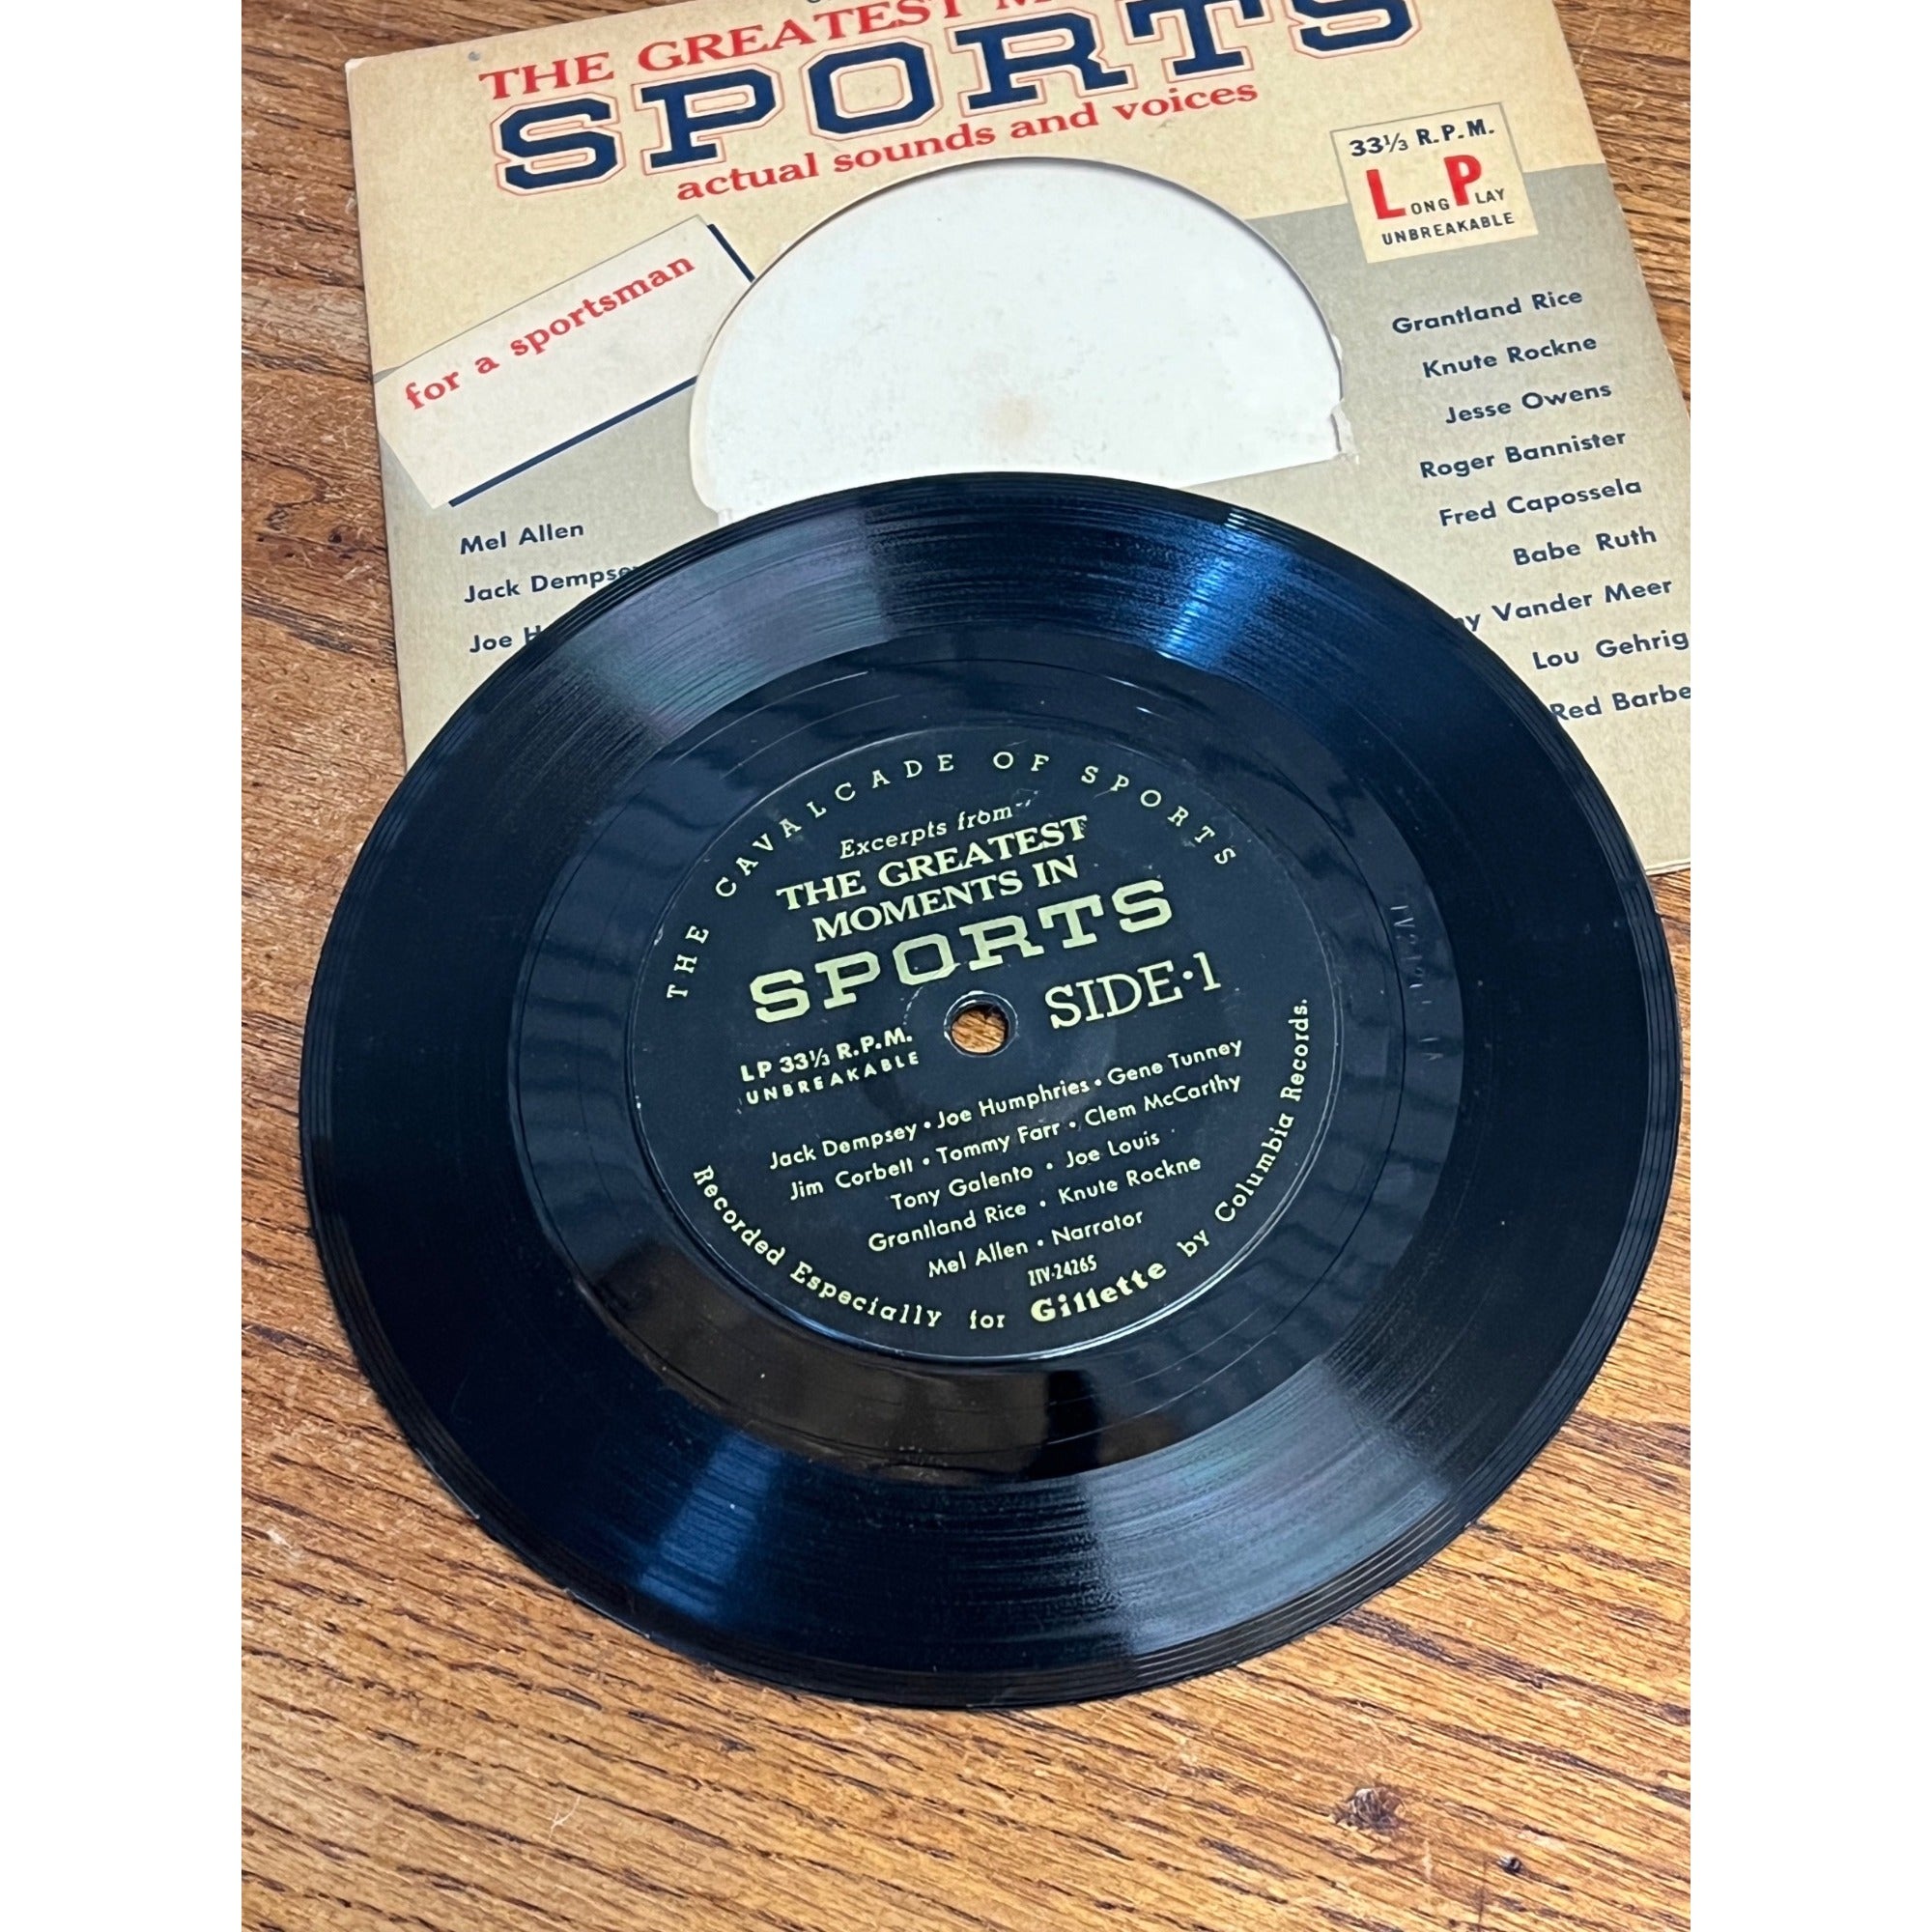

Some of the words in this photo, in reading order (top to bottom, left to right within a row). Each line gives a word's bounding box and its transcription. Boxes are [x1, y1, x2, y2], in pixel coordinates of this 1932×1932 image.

[478, 52, 614, 99] THE
[638, 0, 962, 72] GREATEST
[490, 0, 1422, 196] SPORTS
[676, 153, 818, 201] actual
[834, 121, 995, 172] sounds
[1009, 101, 1099, 140] and
[1113, 81, 1258, 121] voices
[1416, 119, 1495, 146] R.P.M.
[1381, 212, 1515, 246] UNBREAKABLE
[406, 371, 460, 410] for
[474, 356, 500, 374] a
[510, 257, 696, 356] sportsman
[1392, 298, 1521, 333] Grantland
[1532, 291, 1583, 311] Rice
[1422, 354, 1497, 379] Knute
[1506, 337, 1598, 364] Rockne
[1445, 401, 1512, 424] Jesse
[1521, 384, 1612, 410] Owens
[1419, 454, 1495, 478] Roger
[1505, 432, 1626, 464] Bannister
[1439, 500, 1496, 526] Fred
[1506, 478, 1642, 514] Capossela
[460, 530, 506, 555] Mel
[518, 523, 584, 546] Allen
[1513, 542, 1581, 566] Babe
[1596, 526, 1657, 552] Ruth
[464, 579, 521, 604] Jack
[530, 565, 639, 593] Dempse
[1492, 593, 1593, 622] Vander
[1605, 580, 1672, 603] Meer
[469, 635, 513, 653] Joe
[1532, 650, 1579, 669] Lou
[1595, 630, 1690, 658] Gehrig
[1549, 696, 1603, 721] Red
[839, 820, 947, 860] Excerpts
[957, 807, 1013, 831] from
[667, 924, 709, 999] THE
[715, 753, 954, 897] CAVALCADE
[993, 752, 1049, 772] OF
[1081, 765, 1236, 865] SPORTS
[776, 870, 867, 911] THE
[878, 815, 1088, 887] GREATEST
[811, 869, 1023, 943] MOMENTS
[1032, 854, 1079, 888] IN
[750, 879, 1173, 1023] SPORTS
[740, 1061, 773, 1083] LP
[836, 1027, 913, 1061] R.P.M.
[746, 1051, 920, 1105] UNBREAKABLE
[769, 1144, 817, 1171] Jack
[822, 1122, 918, 1158] Dempsey
[937, 1109, 973, 1130] Joe
[978, 1079, 1091, 1118] Humphries
[1107, 1063, 1164, 1086] Gene
[1168, 1039, 1242, 1069] Tunney
[693, 1165, 785, 1265] Recorded
[789, 1261, 942, 1327] Especially
[969, 1309, 1006, 1329] for
[1030, 1262, 1167, 1322] Gillette
[1176, 1229, 1210, 1258] by
[1214, 1113, 1294, 1223] Columbia
[1280, 999, 1310, 1101] Records.
[790, 1181, 824, 1201] Jim
[835, 1157, 913, 1189] Corbett
[936, 1135, 1010, 1165] Tommy
[1017, 1122, 1061, 1145] Farr
[1085, 1102, 1137, 1126] Clem
[1144, 1074, 1241, 1112] McCarthy
[891, 1189, 941, 1210] Tony
[948, 1166, 1034, 1197] Galento
[1066, 1148, 1100, 1169] Joe
[1107, 1130, 1160, 1157] Louis
[868, 1210, 977, 1252] Grantland
[984, 1203, 1027, 1224] Rice
[1058, 1179, 1119, 1205] Knute
[1125, 1157, 1201, 1187] Rockne
[928, 1251, 966, 1278] Mel
[975, 1240, 1029, 1267] Allen
[1051, 1211, 1144, 1246] Narrator
